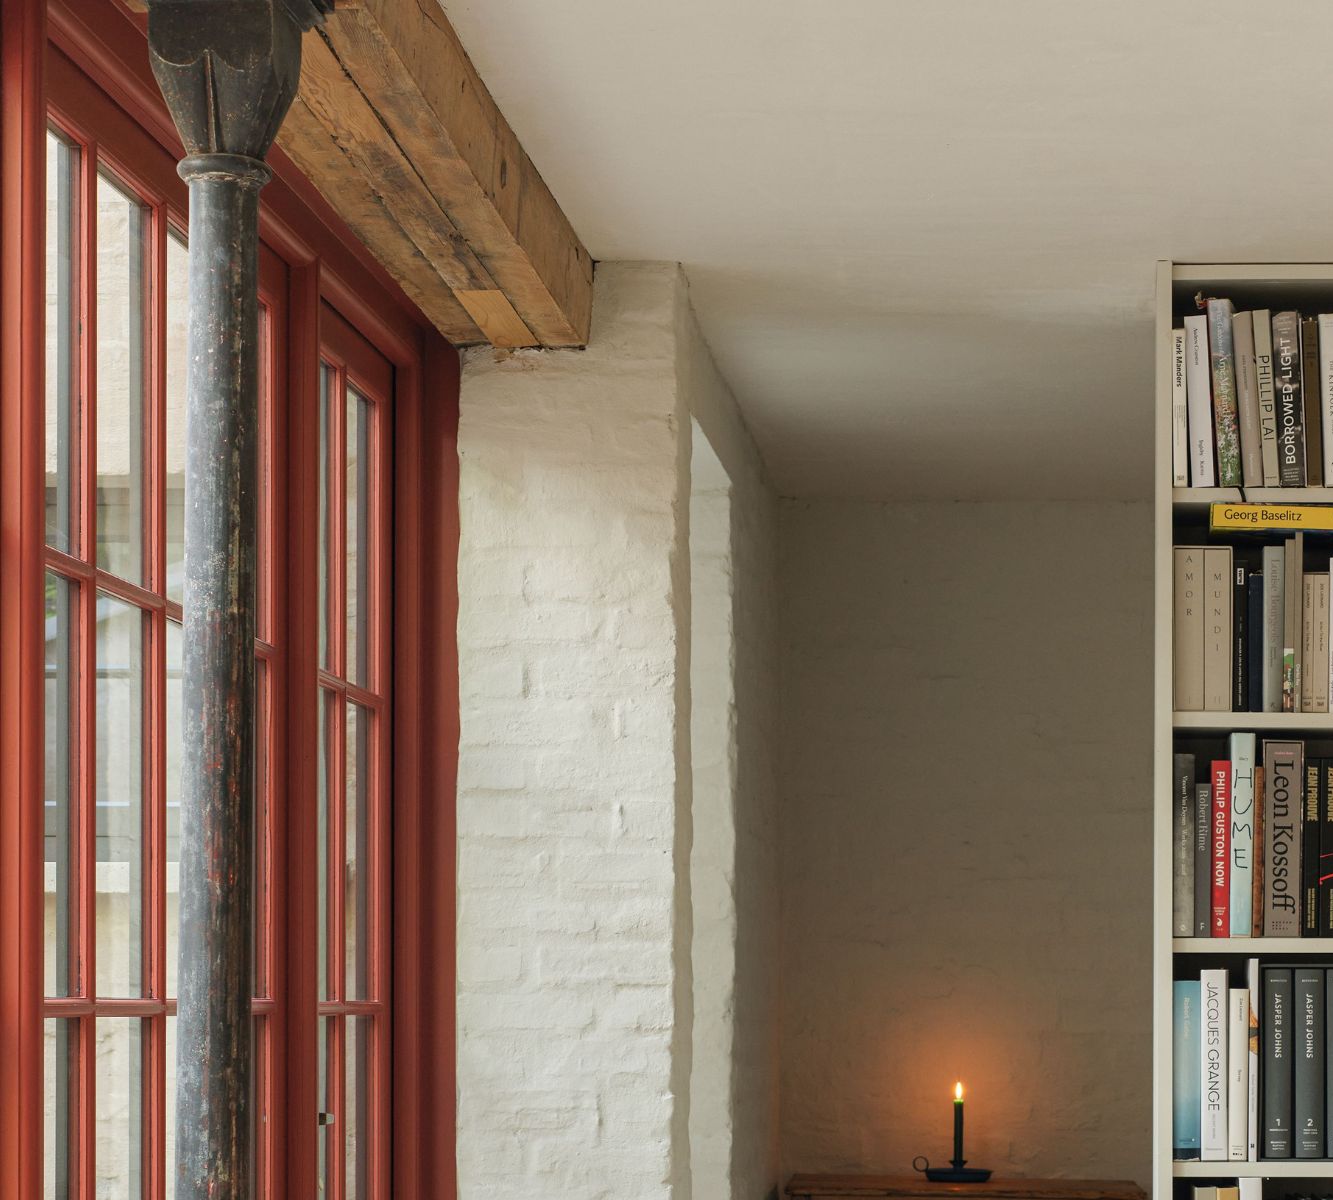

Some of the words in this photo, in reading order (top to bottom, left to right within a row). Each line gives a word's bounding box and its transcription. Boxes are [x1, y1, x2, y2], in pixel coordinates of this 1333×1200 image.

[1280, 338, 1292, 379] LIGHT
[1258, 355, 1272, 413] PHILLIP
[1263, 417, 1274, 440] LAI
[1282, 385, 1296, 464] BORROWED
[1224, 509, 1258, 522] Georg
[1261, 510, 1302, 521] Baselitz
[1271, 559, 1280, 592] Louise
[1269, 595, 1280, 643] Bourgeois
[1216, 771, 1224, 808] PHILIP
[1273, 761, 1294, 817] Leon
[1307, 766, 1317, 787] JEAN
[1199, 790, 1208, 823] Robert
[1307, 788, 1318, 821] PROUVÉ
[1198, 825, 1207, 850] Kime
[1216, 812, 1224, 857] GUSTON
[1216, 861, 1224, 887] NOW
[1272, 823, 1295, 914] Kossoff
[1207, 982, 1218, 1045] JACQUES
[1274, 993, 1282, 1025] JASPER
[1208, 1049, 1219, 1111] GRANGE
